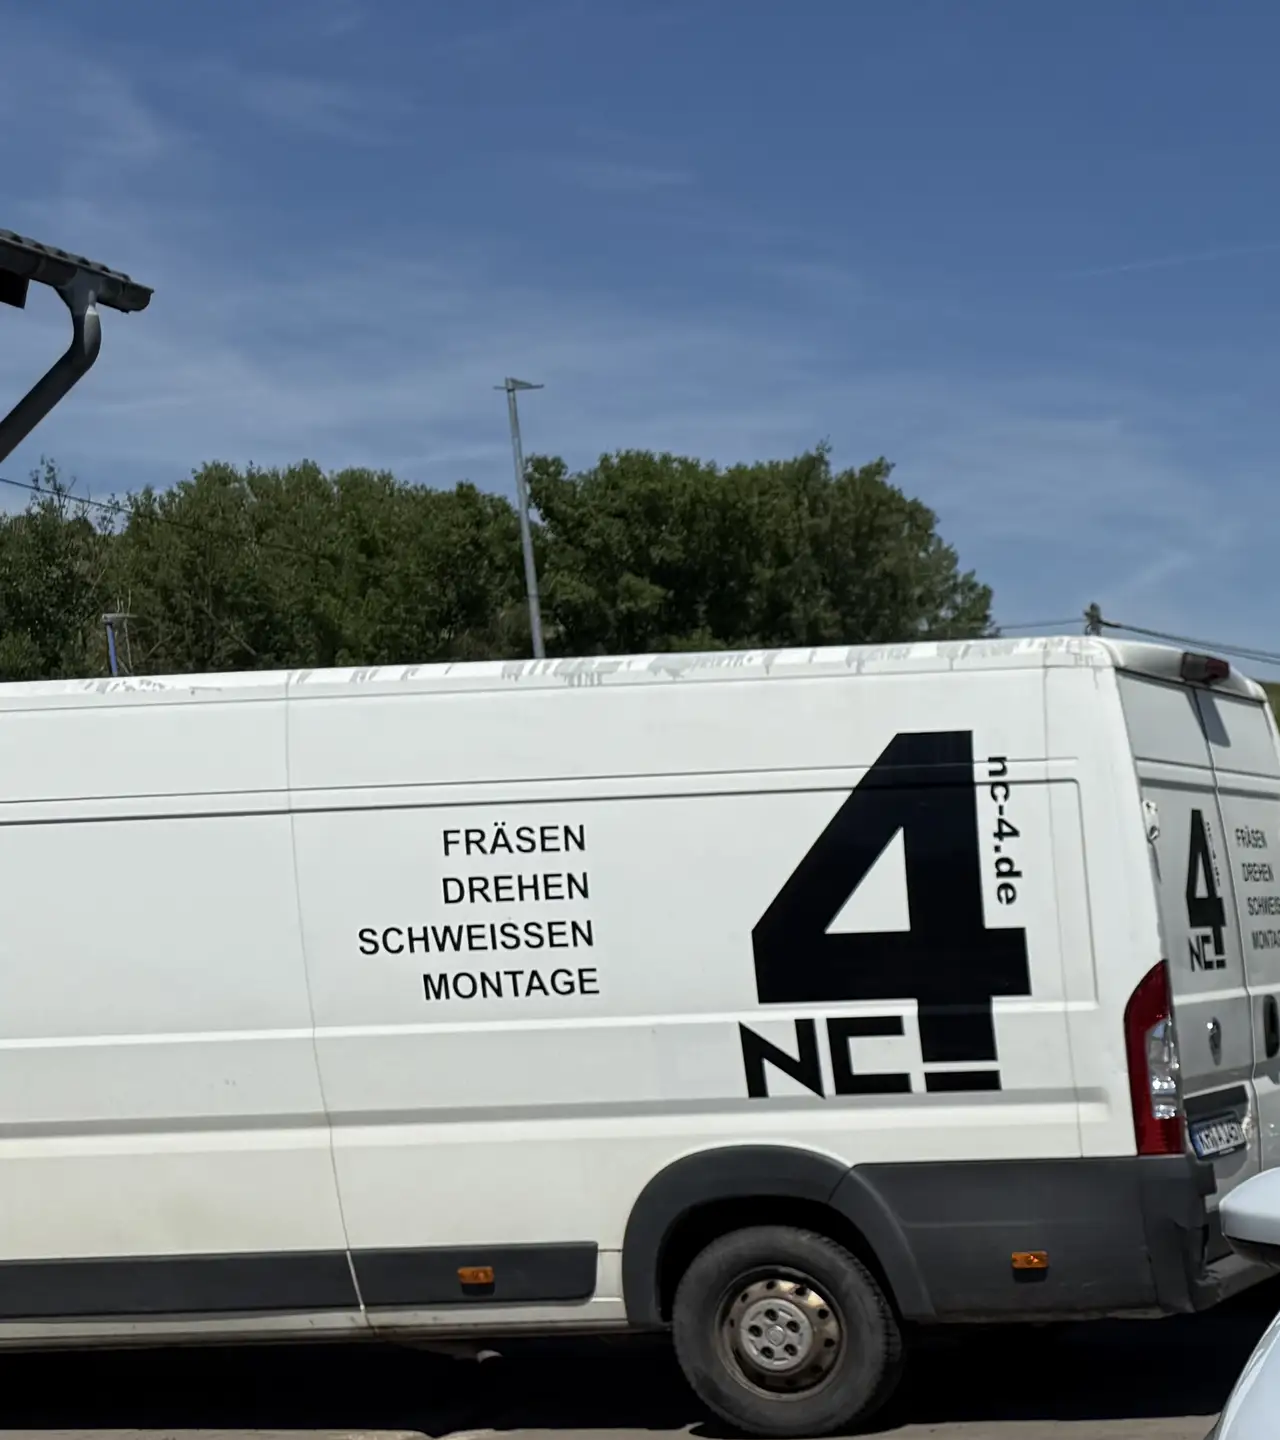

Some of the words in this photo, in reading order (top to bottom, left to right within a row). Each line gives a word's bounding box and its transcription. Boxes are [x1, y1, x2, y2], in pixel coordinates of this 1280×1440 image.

[443, 821, 586, 857] FRÄSEN
[987, 756, 1023, 906] nc-4.de
[442, 871, 590, 905] DREHEN
[358, 919, 594, 955] SCHWEISSEN
[422, 967, 600, 1001] MONTAGE
